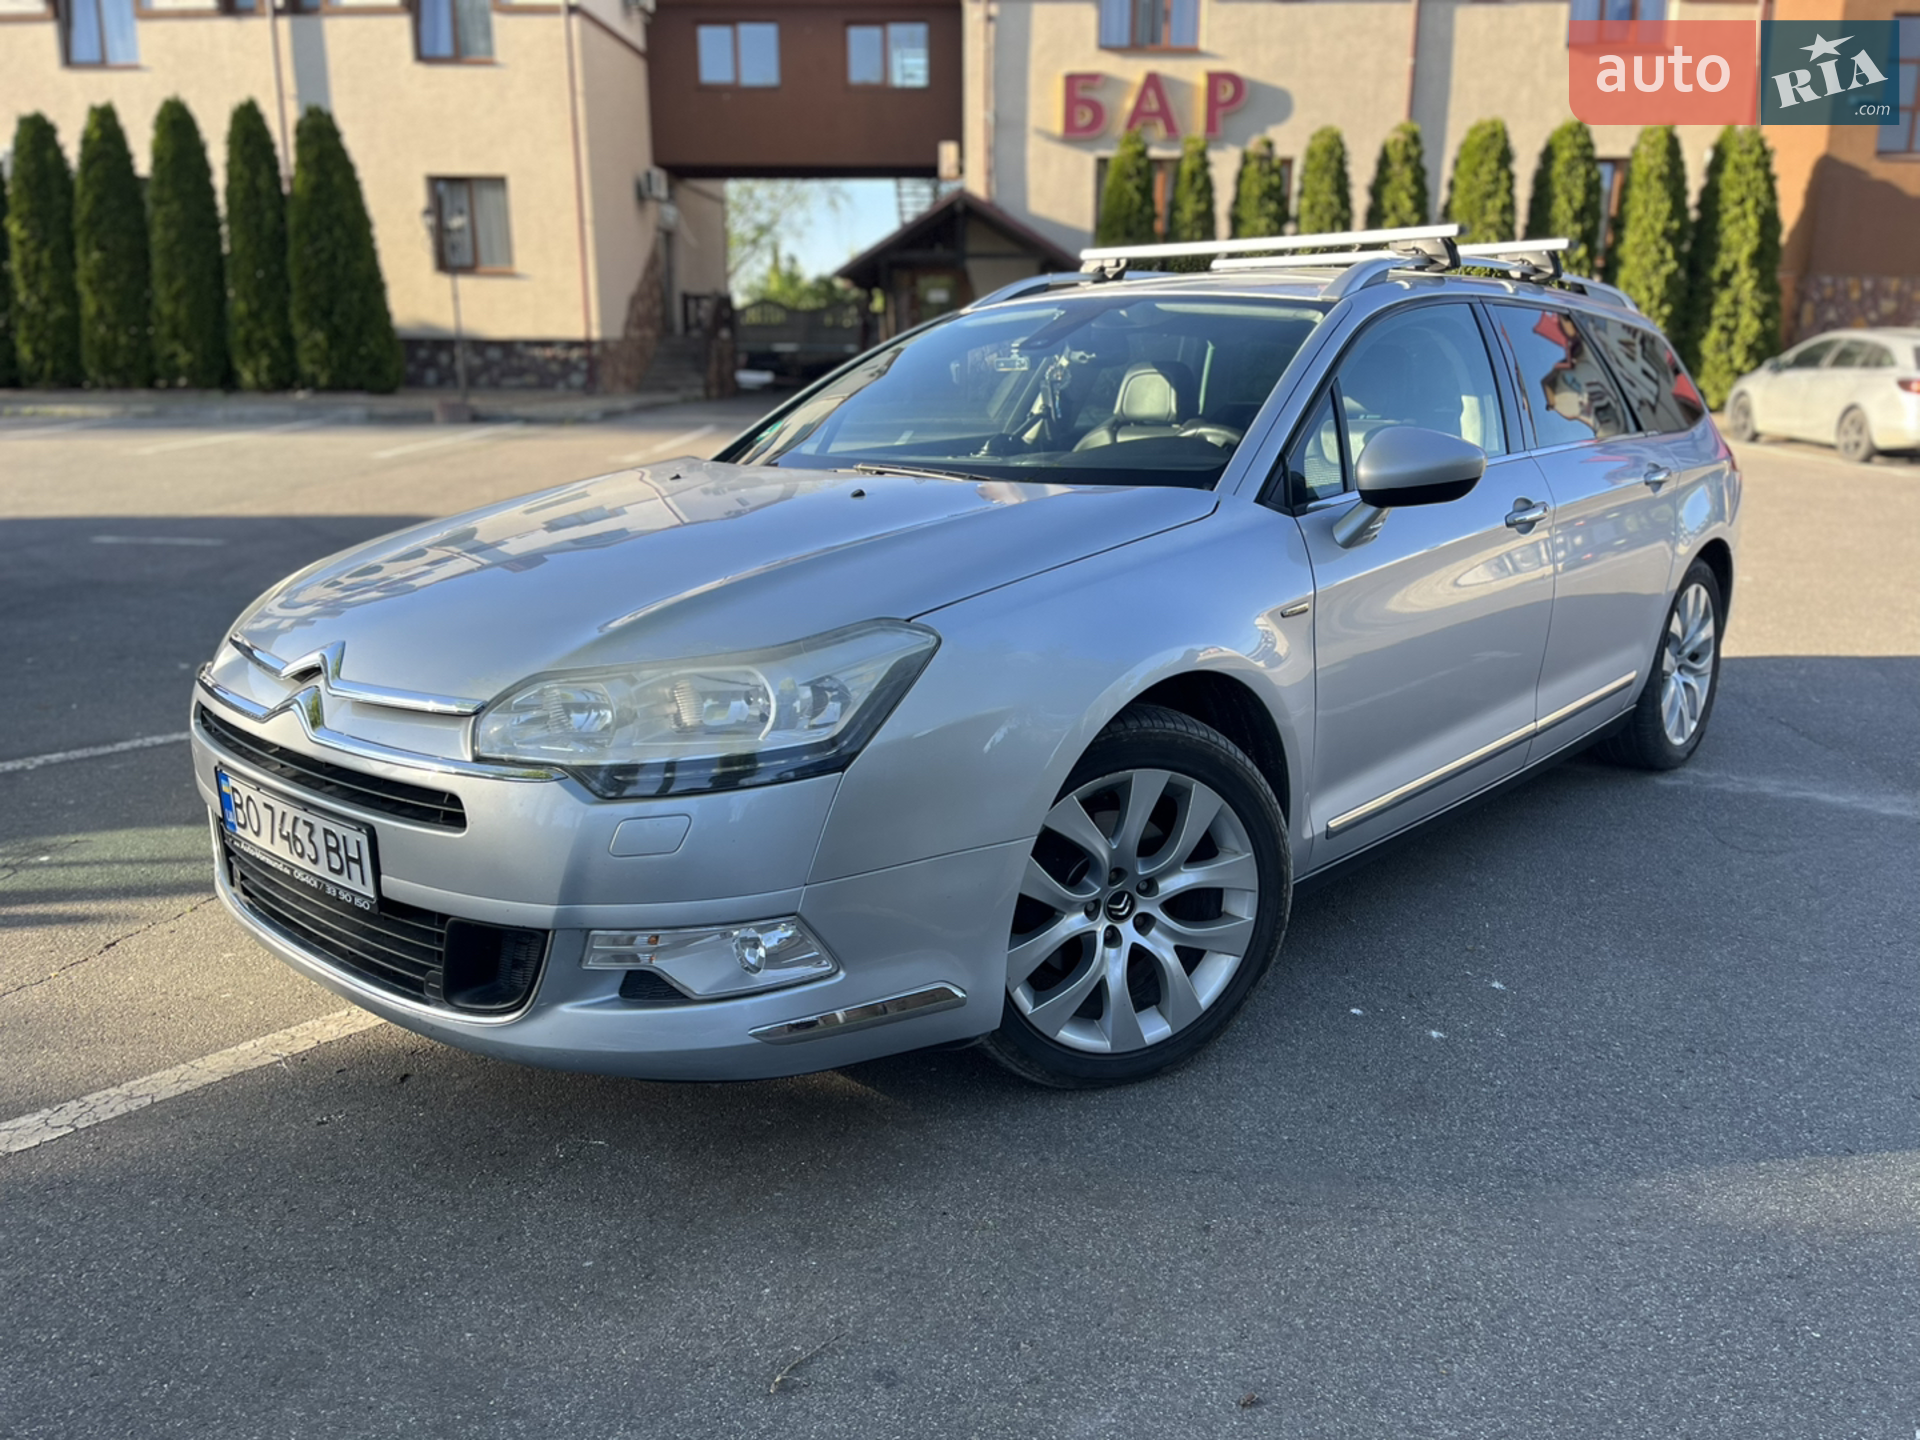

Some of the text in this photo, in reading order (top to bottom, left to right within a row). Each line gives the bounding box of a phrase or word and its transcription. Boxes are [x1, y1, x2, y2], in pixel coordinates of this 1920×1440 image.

[1061, 70, 1247, 140] БАР
[263, 802, 319, 866] 7463
[322, 827, 367, 887] BH
